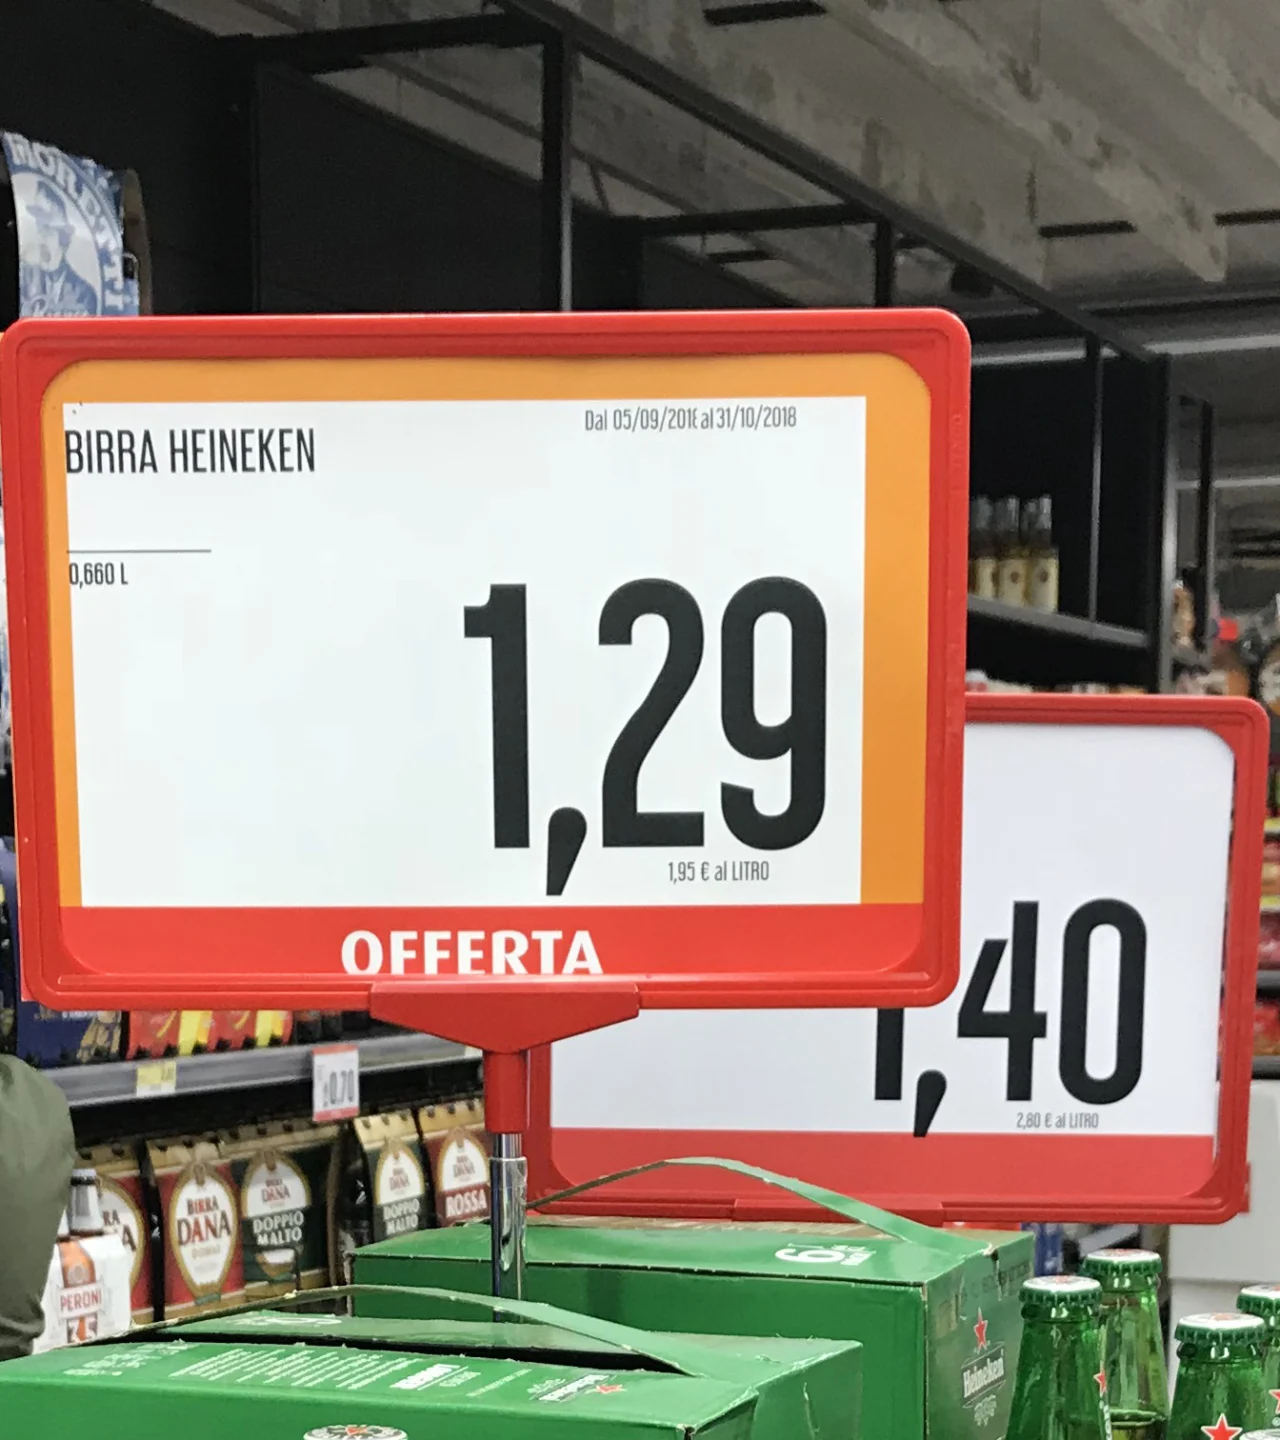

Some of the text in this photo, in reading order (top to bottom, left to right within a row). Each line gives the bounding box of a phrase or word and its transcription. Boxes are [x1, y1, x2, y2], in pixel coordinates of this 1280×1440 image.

[584, 409, 608, 431] Dal
[700, 408, 714, 430] al
[716, 407, 797, 431] 31/10/2018
[65, 428, 315, 474] BIRRA HEINEKEN
[68, 563, 129, 588] 0,660 L
[463, 575, 828, 896] 1,29
[667, 860, 770, 884] 1,95 € al LITRO
[341, 929, 604, 976] OFFERTA
[1016, 1111, 1041, 1129] 2,80
[1056, 1111, 1067, 1128] al
[1069, 1111, 1100, 1129] LITRO
[187, 1199, 218, 1215] BIRRA
[383, 1199, 420, 1219] DOPPIO
[445, 1189, 488, 1217] ROSSA
[177, 1215, 231, 1246] DANA
[252, 1211, 305, 1235] DOPPIO
[384, 1215, 419, 1236] MALTO
[256, 1228, 303, 1245] MALTO
[59, 1288, 103, 1311] PERONI
[963, 1356, 1004, 1399] Heineken
